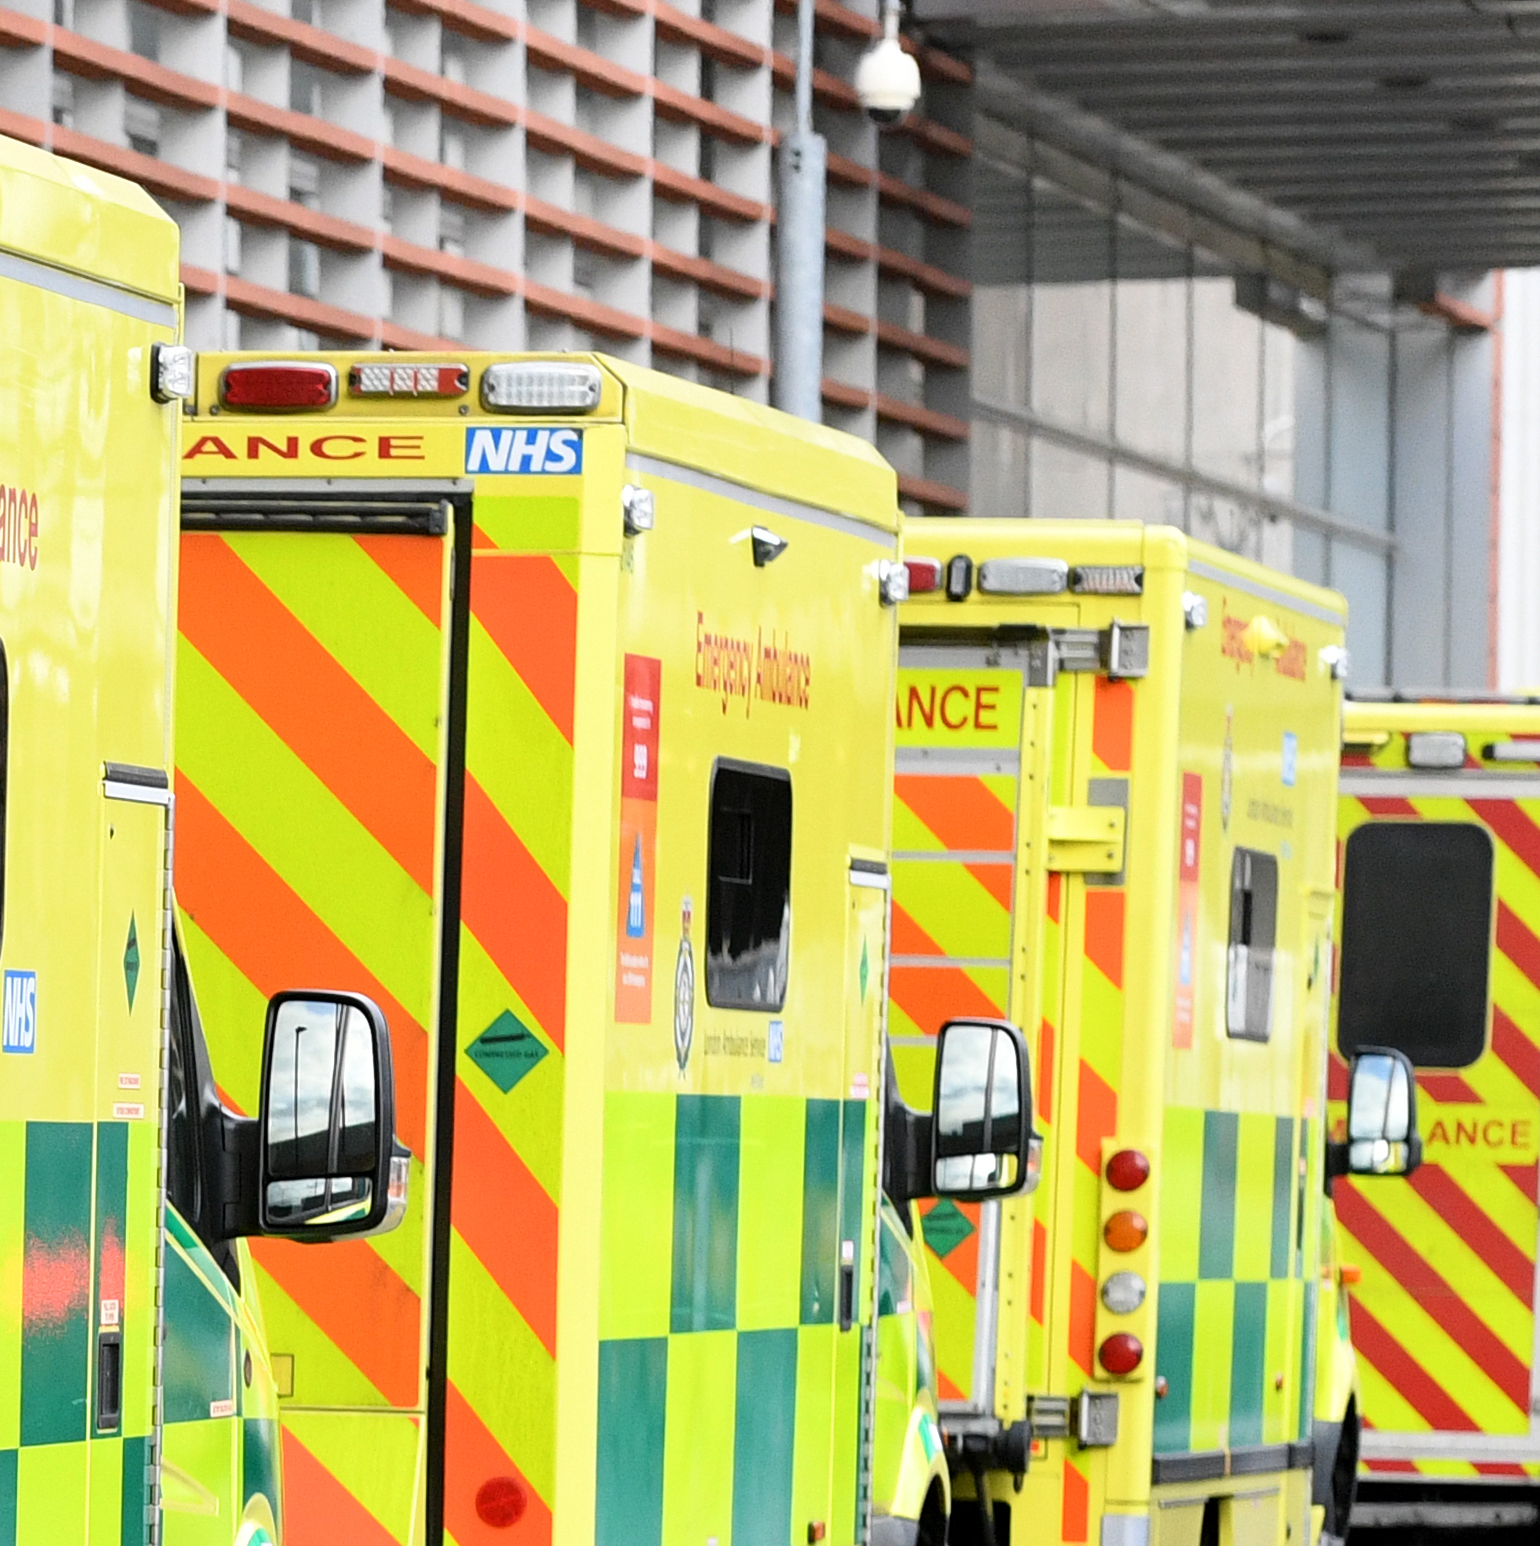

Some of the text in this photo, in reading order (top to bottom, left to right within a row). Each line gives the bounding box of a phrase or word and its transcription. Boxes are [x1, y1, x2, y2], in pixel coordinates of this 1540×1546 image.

[182, 434, 427, 461] ANCE
[467, 427, 582, 474] NHS
[4, 975, 36, 1049] NHS
